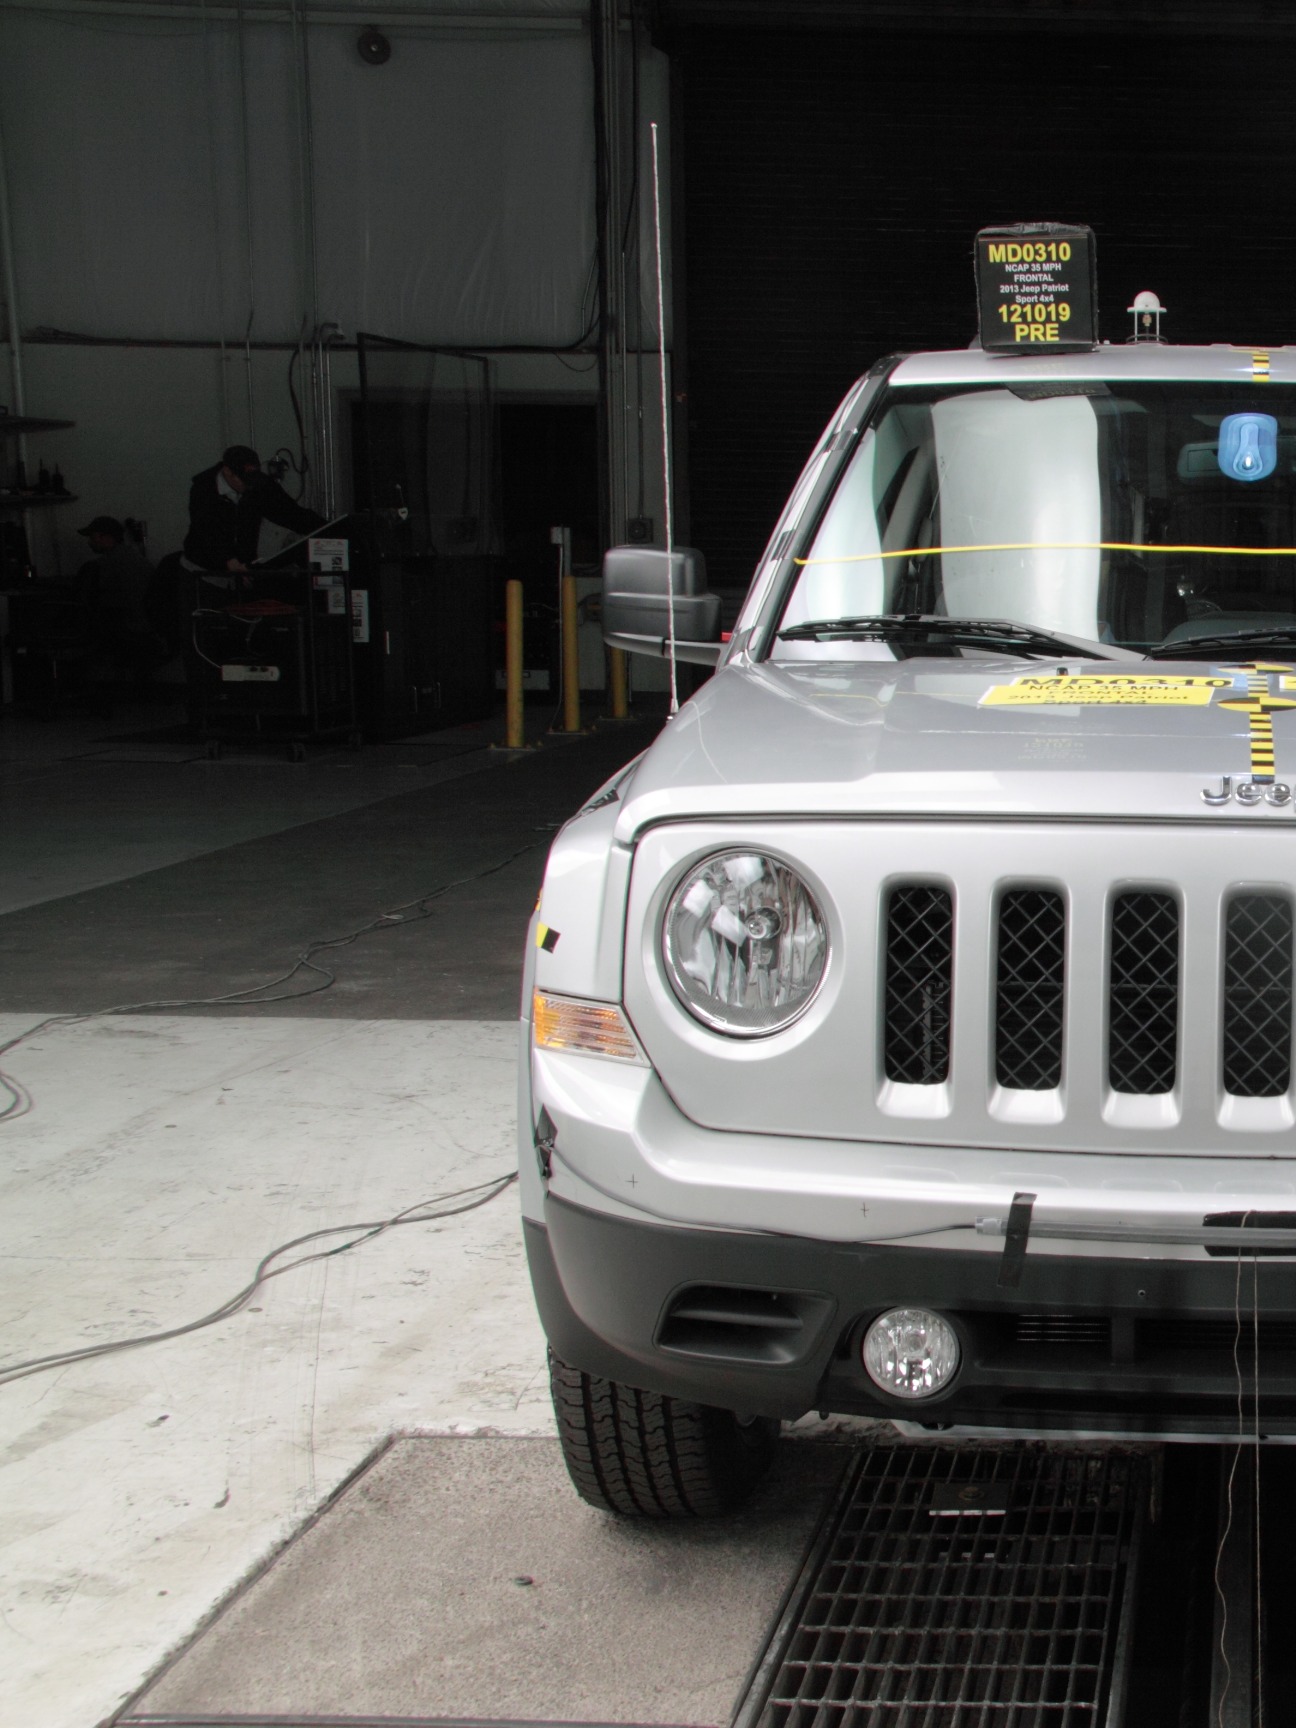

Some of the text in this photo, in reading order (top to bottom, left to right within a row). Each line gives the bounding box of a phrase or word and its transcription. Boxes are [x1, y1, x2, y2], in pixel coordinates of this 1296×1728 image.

[988, 242, 1071, 263] MD0310
[1005, 263, 1061, 272] NCAP 35 MPH
[1014, 274, 1054, 282] FRONTAL
[1000, 284, 1069, 293] 2013 Jeep Patriot
[1015, 295, 1038, 304] Sport
[998, 303, 1071, 322] 121019
[1015, 323, 1060, 342] PRE
[1020, 678, 1232, 687] MD0310
